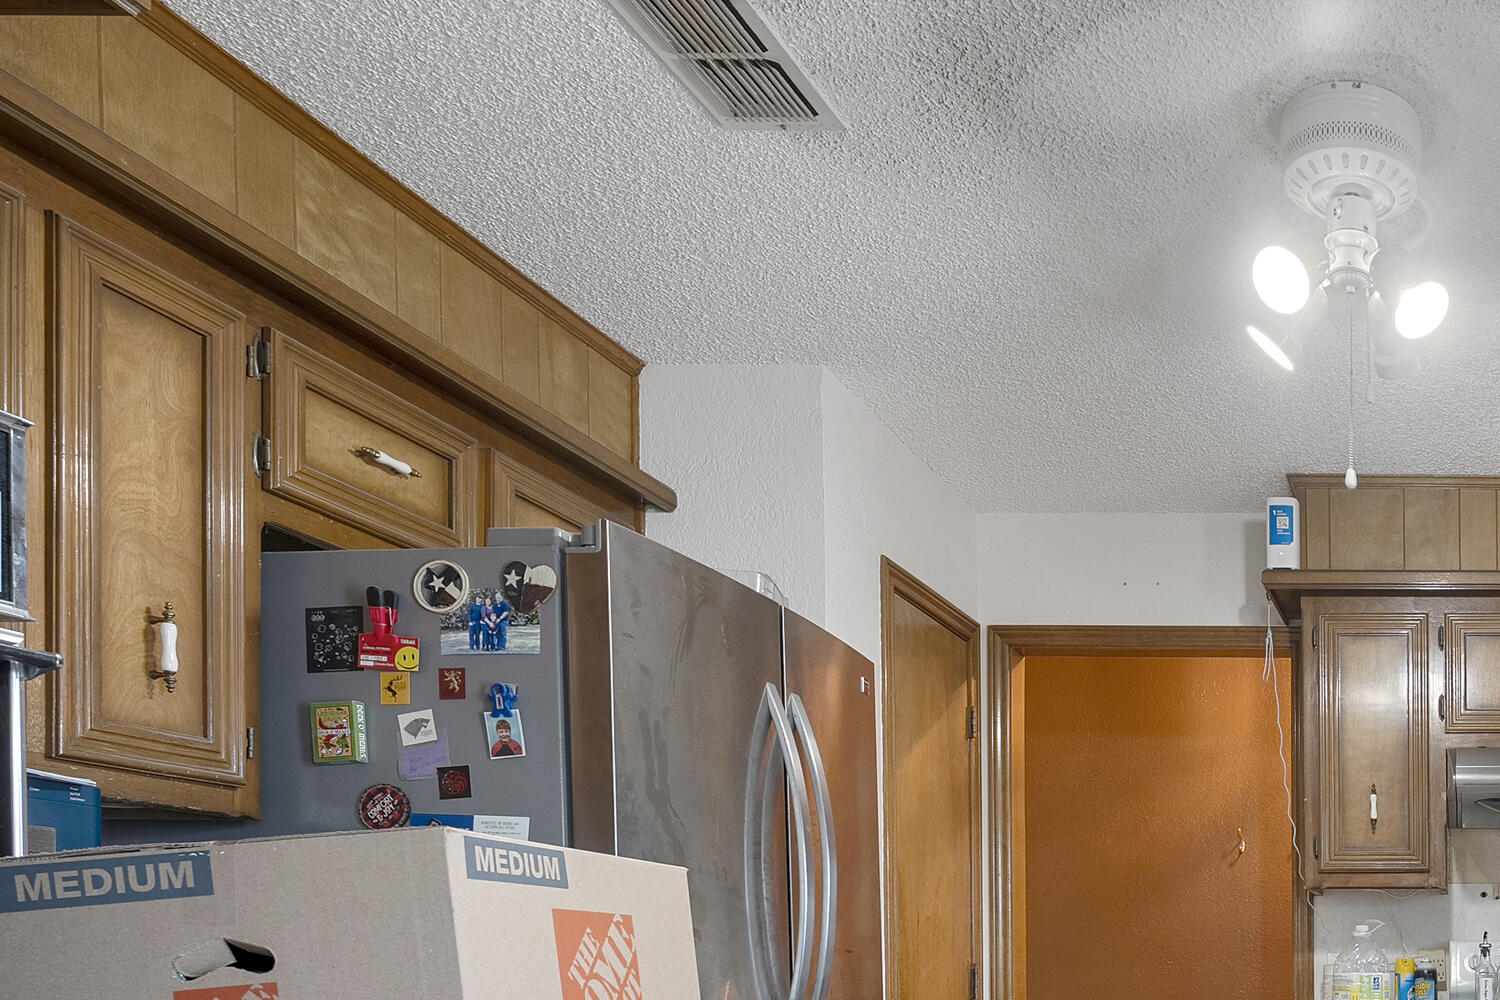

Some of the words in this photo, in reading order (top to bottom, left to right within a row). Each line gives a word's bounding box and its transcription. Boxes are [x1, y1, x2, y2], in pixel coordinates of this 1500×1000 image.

[14, 860, 195, 903] MEDIUM
[474, 846, 561, 881] MEDIUM
[568, 927, 600, 989] THE
